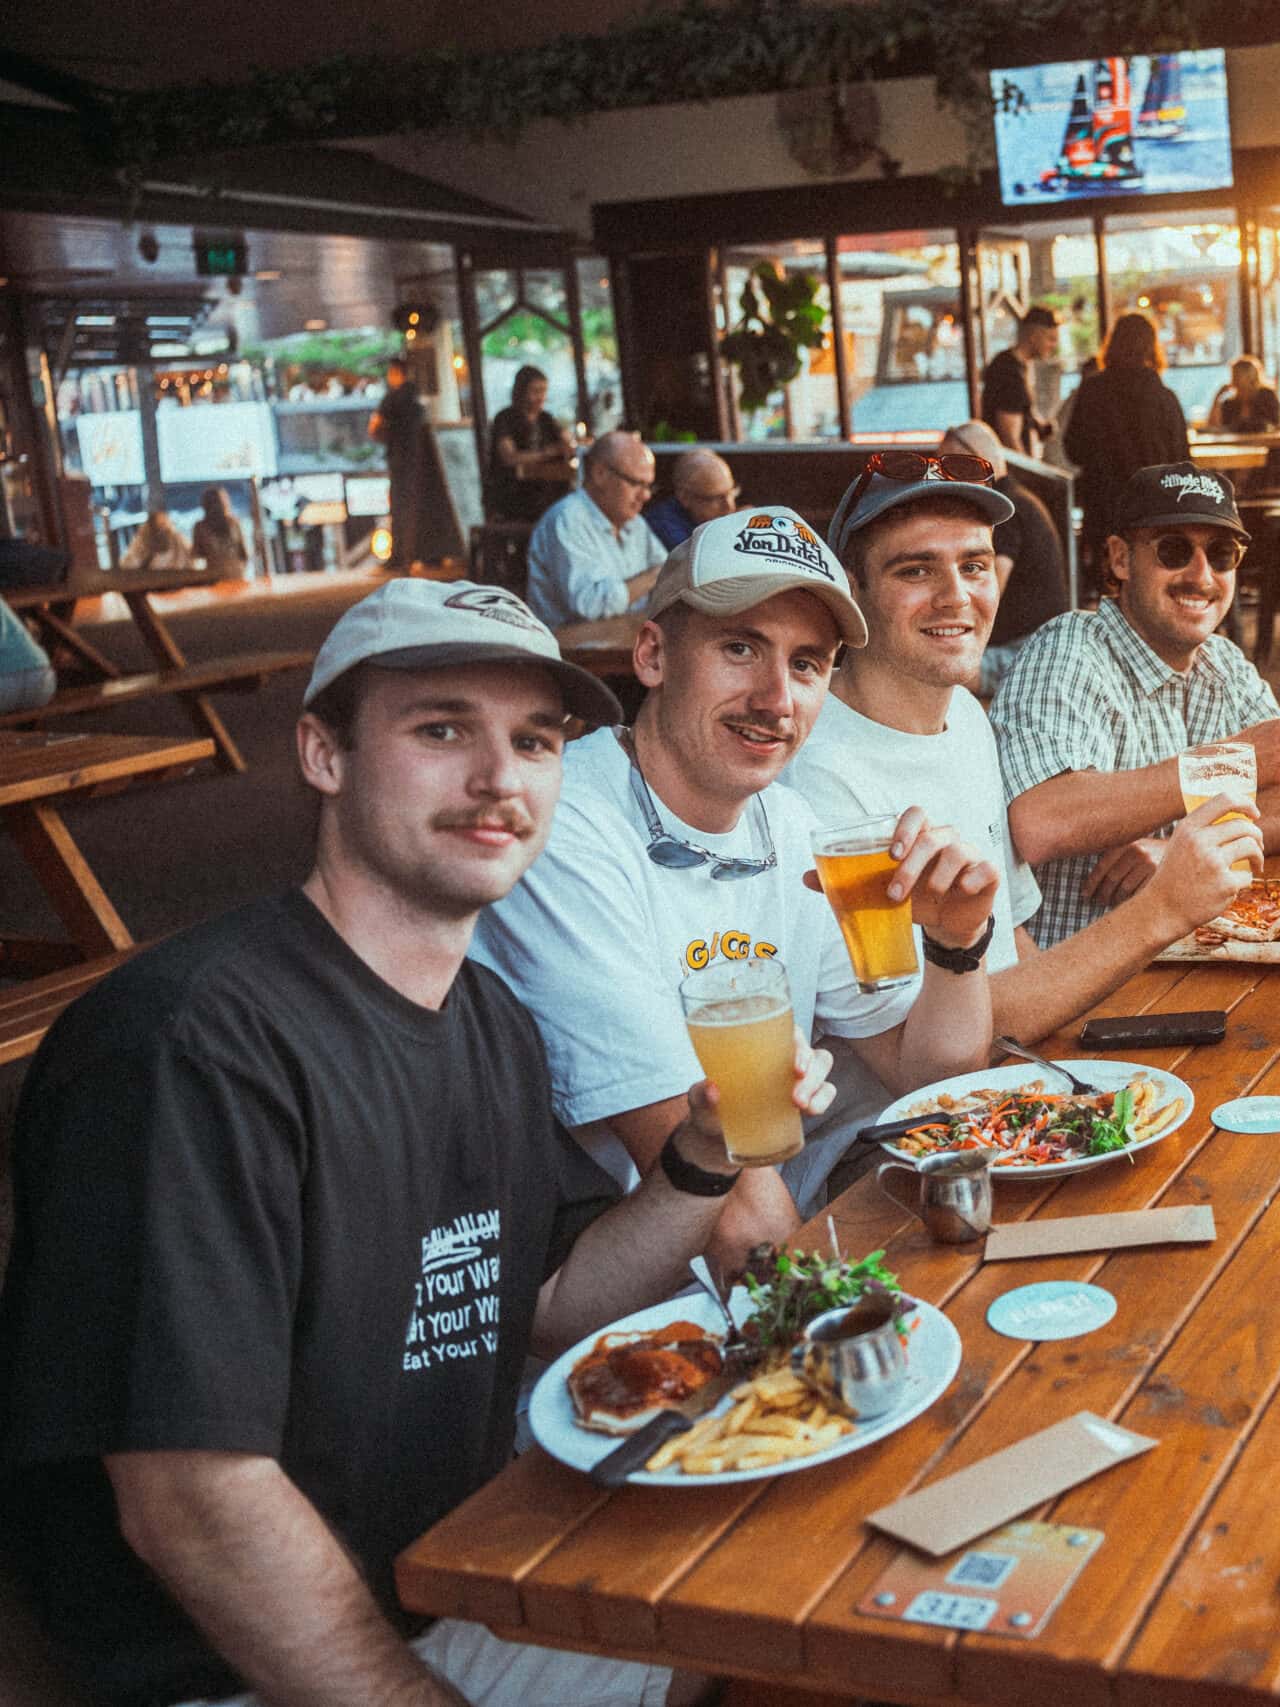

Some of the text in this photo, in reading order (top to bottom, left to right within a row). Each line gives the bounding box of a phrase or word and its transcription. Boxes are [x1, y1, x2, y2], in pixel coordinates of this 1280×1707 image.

[733, 529, 773, 552] Von
[425, 1269, 465, 1303] Your
[427, 1305, 471, 1339] Your
[403, 1350, 430, 1371] Eat
[432, 1338, 478, 1363] Your
